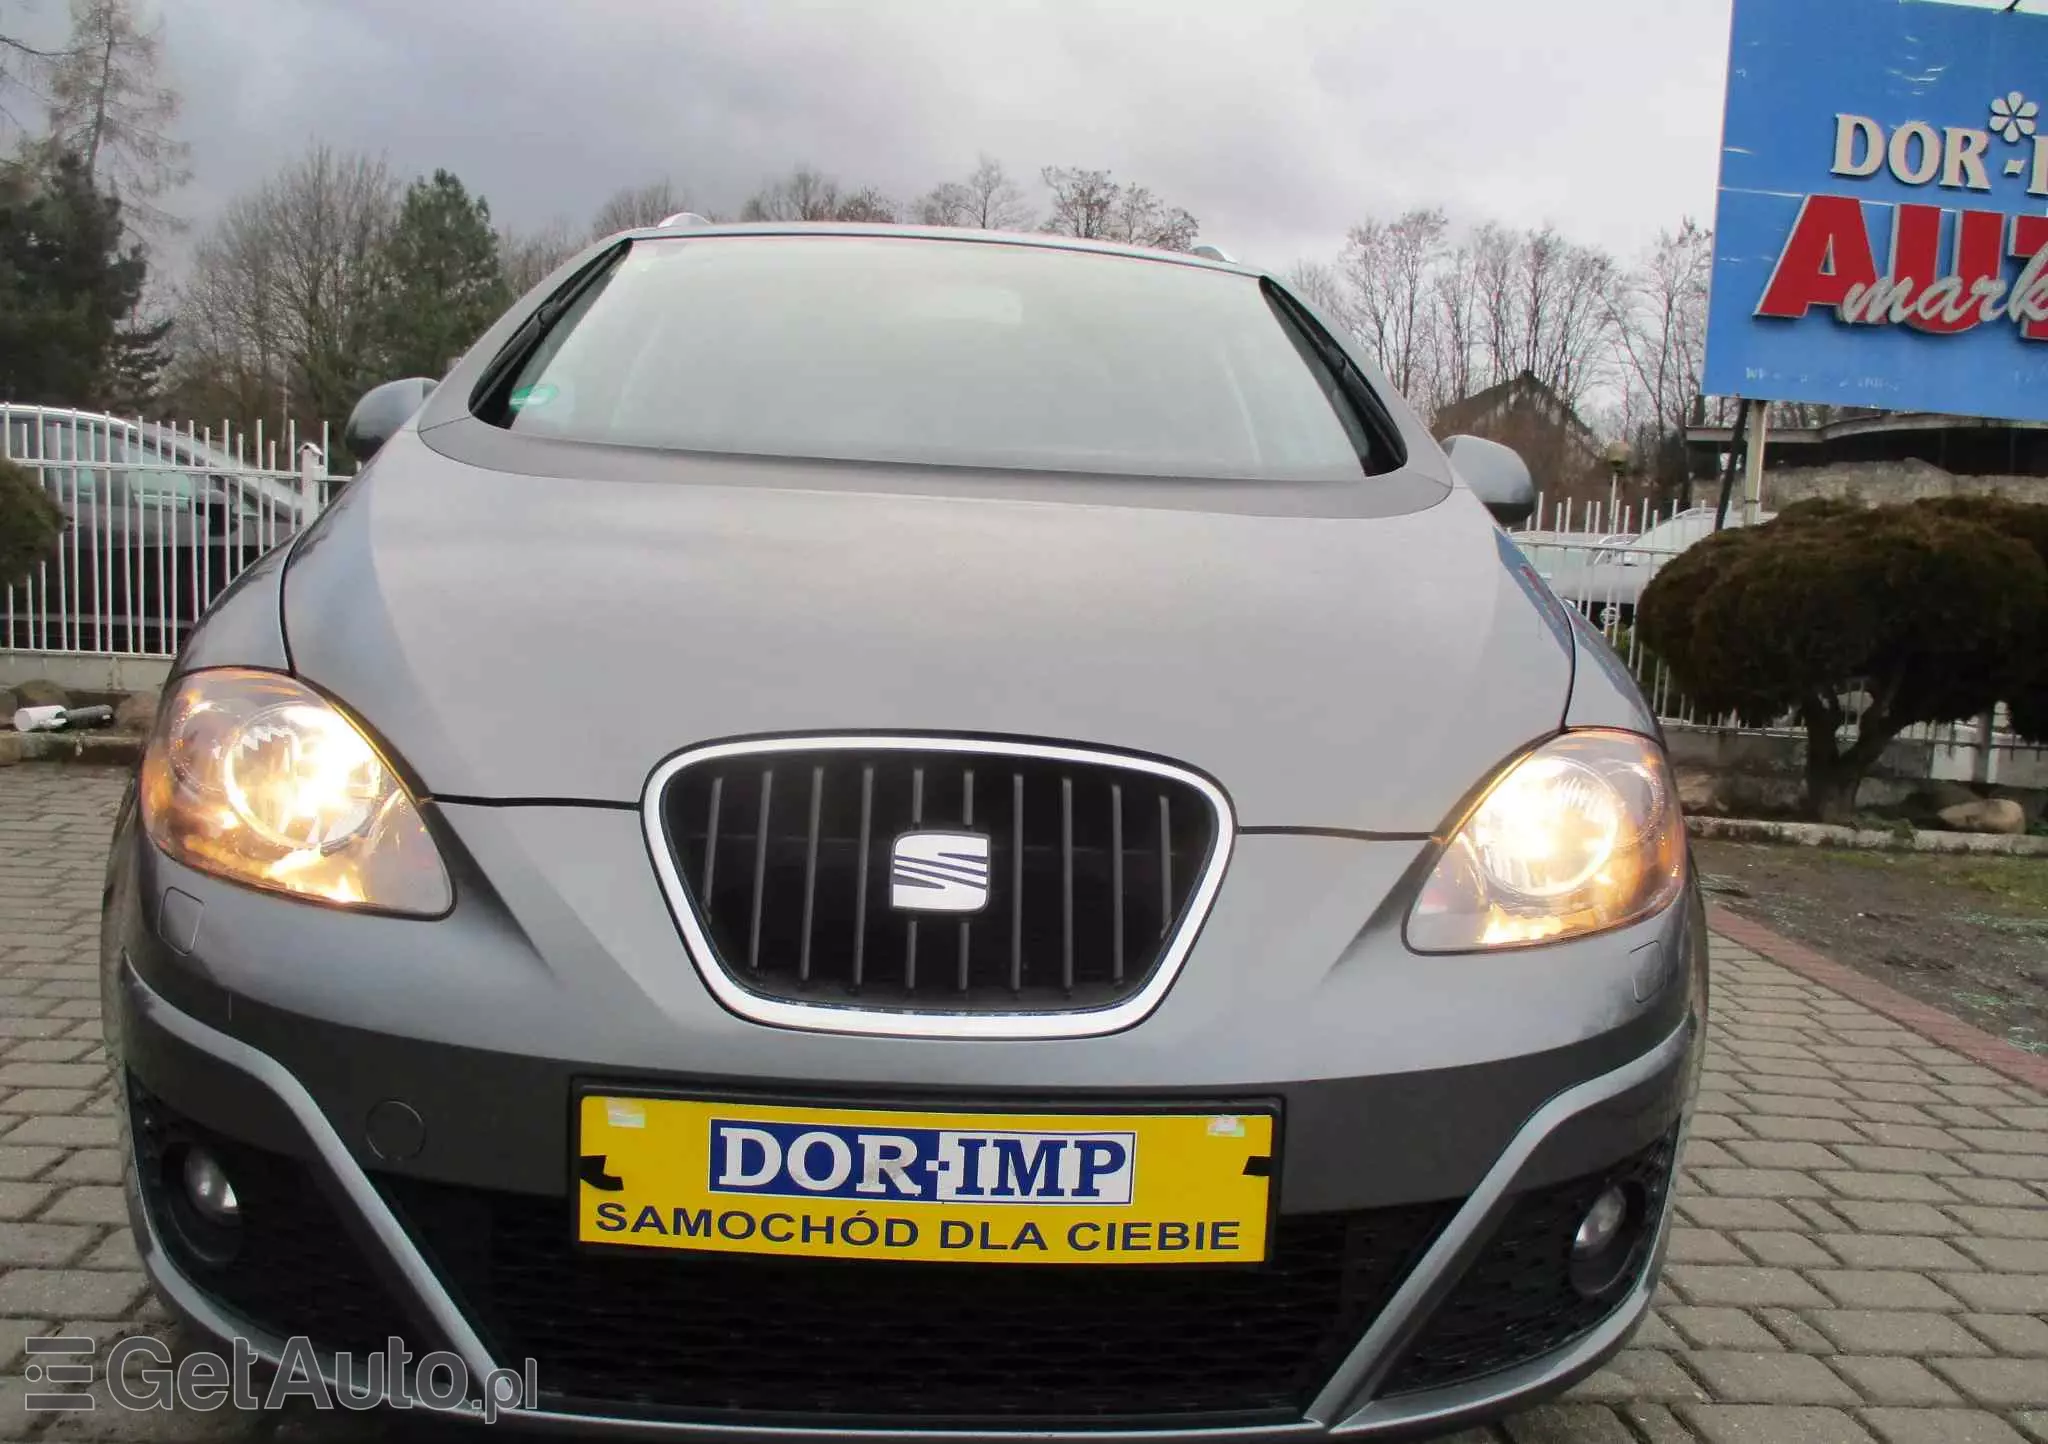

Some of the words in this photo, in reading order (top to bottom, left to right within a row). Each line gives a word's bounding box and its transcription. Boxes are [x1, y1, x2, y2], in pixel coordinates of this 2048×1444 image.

[718, 1125, 1128, 1199] DOR-IMP
[594, 1202, 920, 1250] SAMOCHÓD
[938, 1219, 1049, 1252] DLA
[1066, 1221, 1241, 1252] CIEBIE
